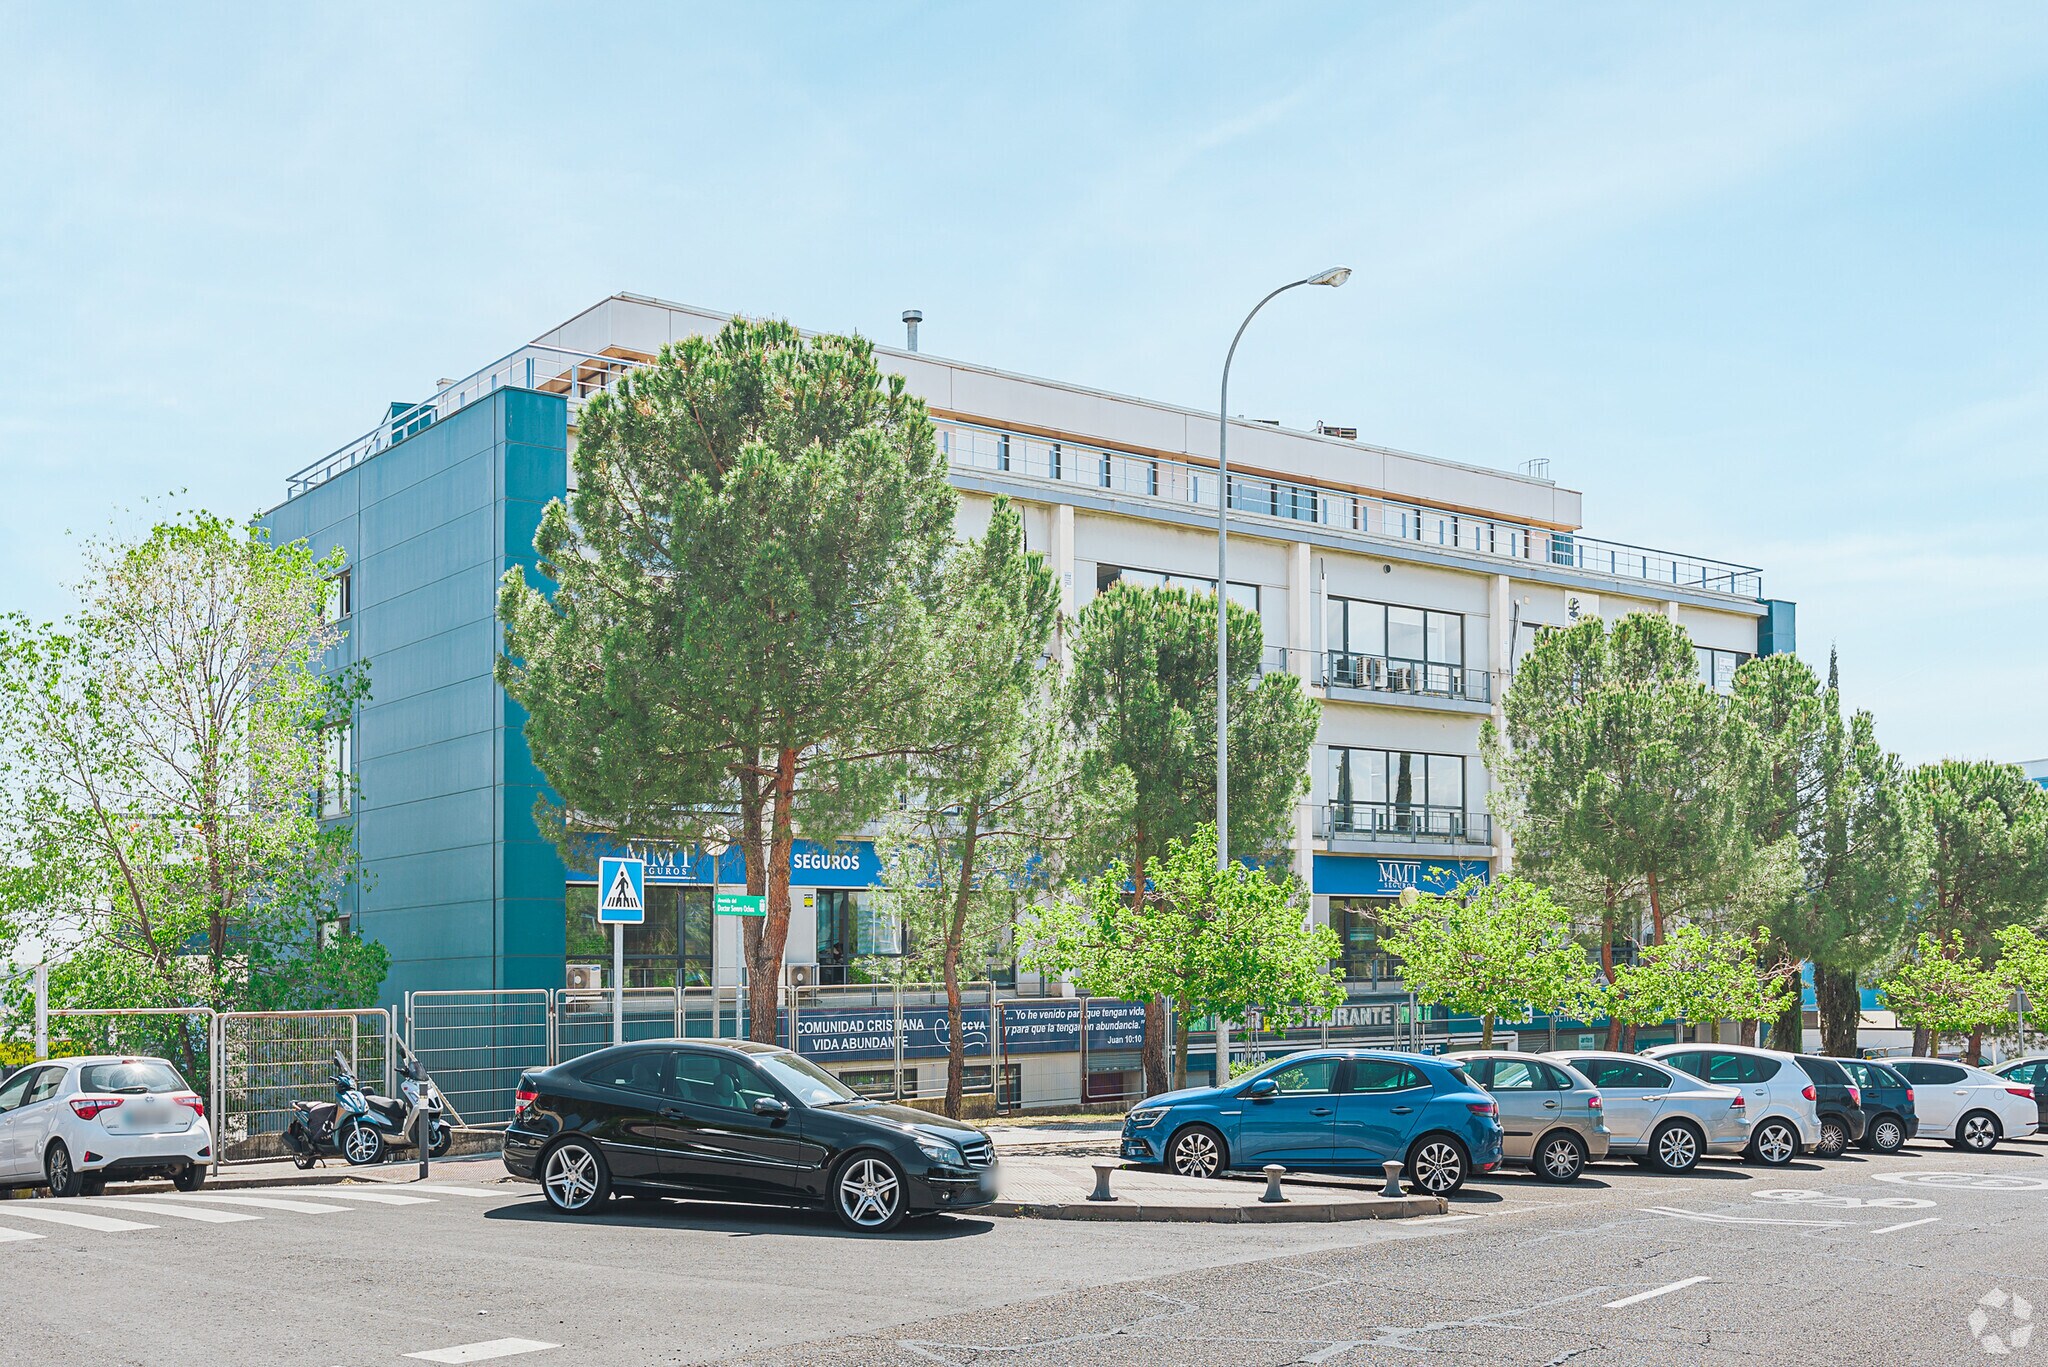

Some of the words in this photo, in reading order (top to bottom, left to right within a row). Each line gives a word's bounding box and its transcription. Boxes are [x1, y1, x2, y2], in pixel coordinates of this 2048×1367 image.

[793, 853, 860, 870] SEGUROS
[643, 867, 687, 875] GUROS
[1378, 863, 1421, 884] MMT
[1016, 1010, 1026, 1020] Yo
[1027, 1010, 1038, 1020] he
[1039, 1009, 1066, 1019] venido
[1101, 1008, 1128, 1019] tengan
[1129, 1006, 1146, 1017] vida,
[1270, 1006, 1392, 1029] ESTAURANTE
[797, 1020, 865, 1034] COMUNIDAD
[961, 1021, 986, 1031] CCVA
[1011, 1026, 1029, 1036] para
[1031, 1025, 1046, 1036] que
[1047, 1023, 1055, 1033] la
[813, 1039, 839, 1050] VIDA
[1107, 1036, 1124, 1044] Juan
[1125, 1035, 1142, 1043] 10:10
